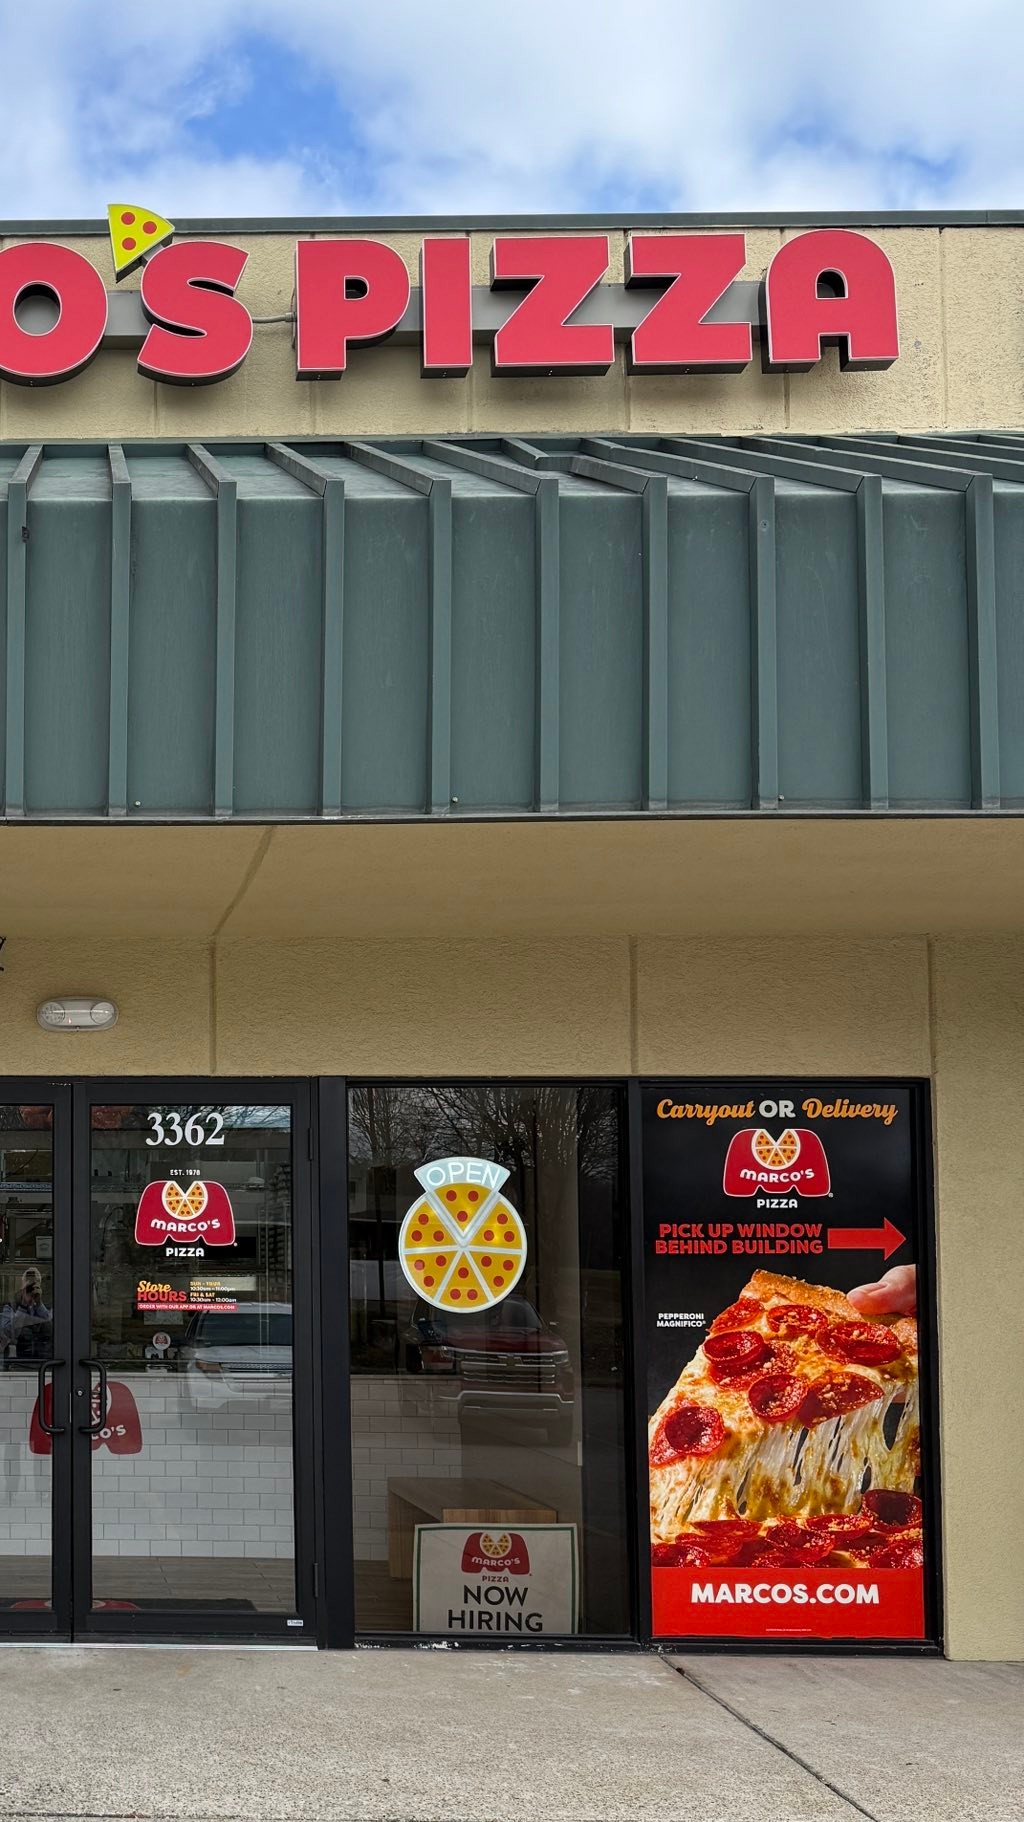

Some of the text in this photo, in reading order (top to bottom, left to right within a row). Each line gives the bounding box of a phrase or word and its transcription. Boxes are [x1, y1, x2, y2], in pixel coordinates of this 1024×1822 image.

[296, 230, 899, 373] PIZZA
[656, 1098, 898, 1126] Carryout OR Delivery
[145, 1112, 225, 1146] 3362
[427, 1163, 500, 1188] OPEN
[739, 1168, 815, 1183] MARCO'S
[756, 1199, 798, 1208] PIZZA
[150, 1218, 221, 1232] MARCO'S
[659, 1223, 823, 1238] PICK UP WINDOW
[165, 1248, 205, 1257] PIZZA
[655, 1240, 823, 1255] BEHIND BUILDING
[137, 1280, 172, 1292] Store
[137, 1290, 187, 1301] HOURS
[472, 1557, 520, 1566] MARCO'S
[464, 1585, 528, 1606] NOW
[691, 1583, 879, 1604] MARCOS.COM
[448, 1610, 543, 1632] HIRING
